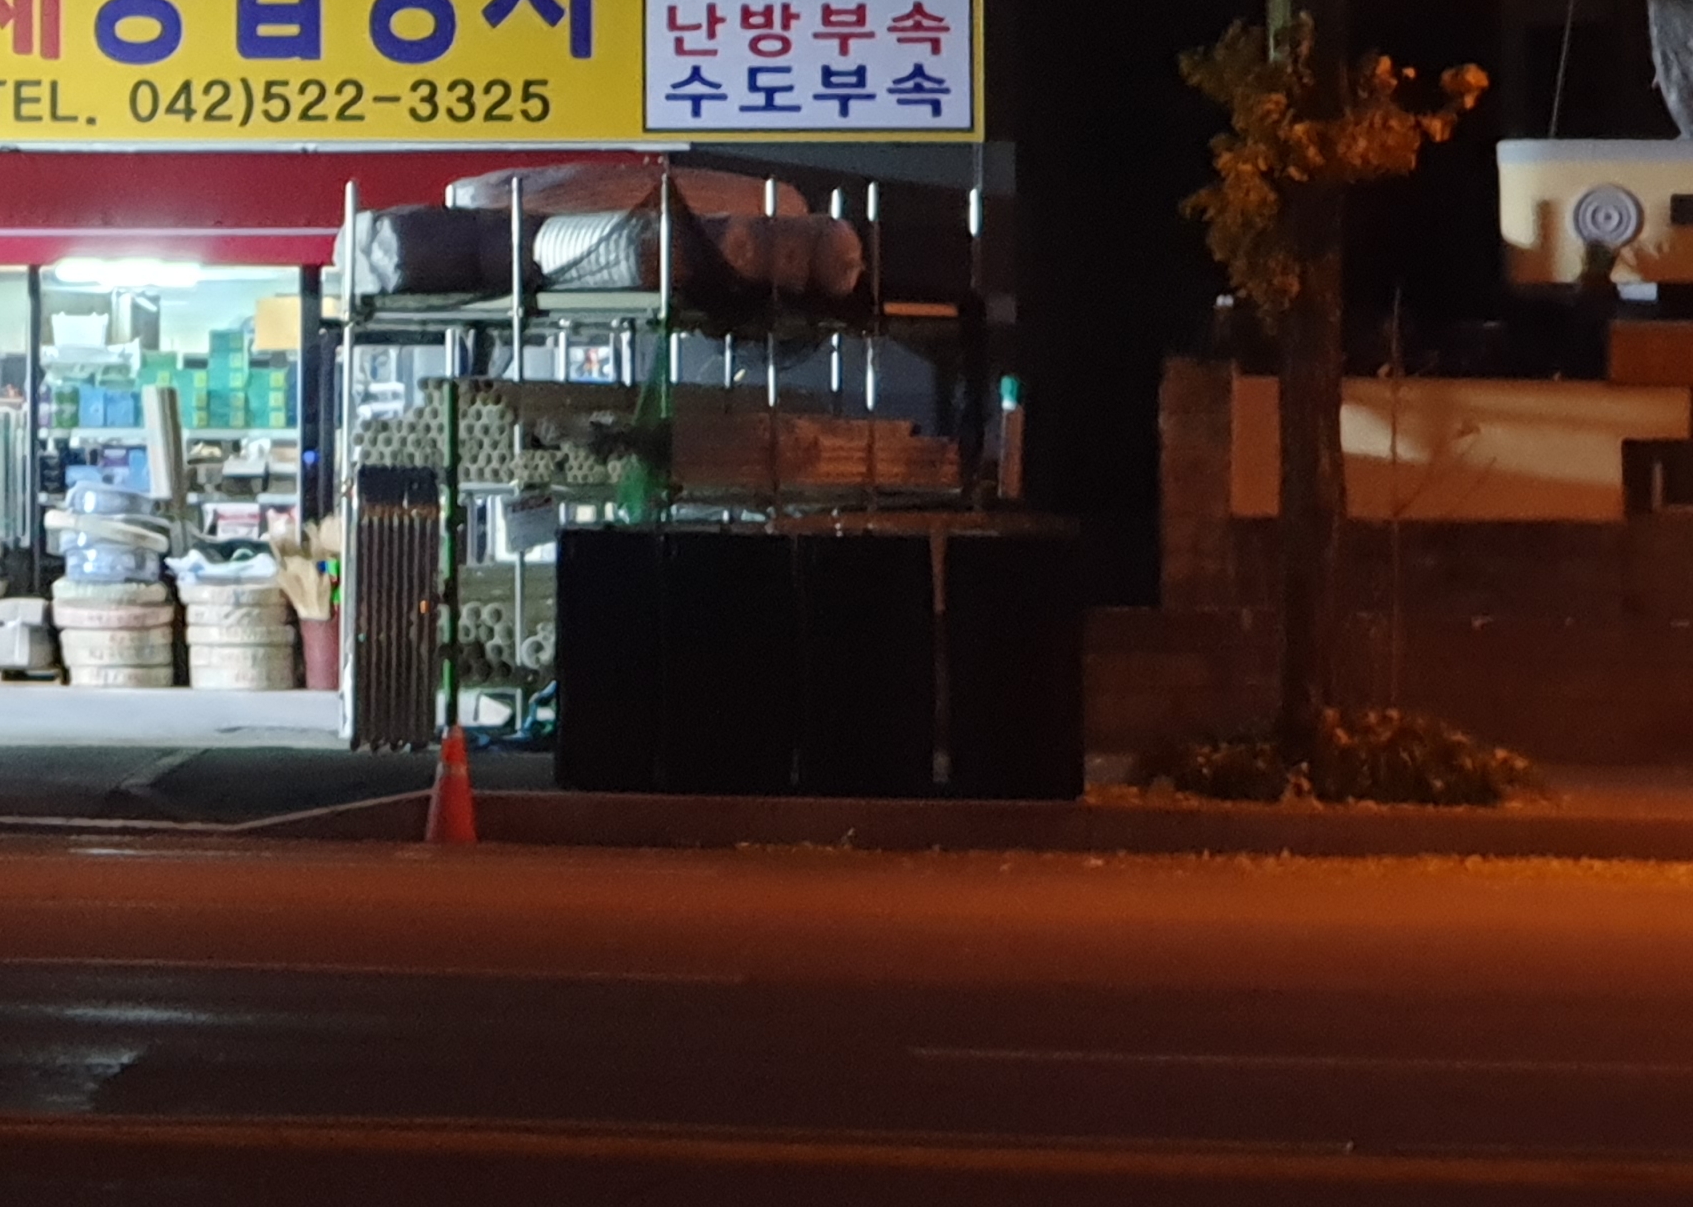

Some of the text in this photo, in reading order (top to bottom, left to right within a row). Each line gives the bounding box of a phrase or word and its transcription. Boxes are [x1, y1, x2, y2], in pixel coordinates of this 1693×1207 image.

[665, 1, 952, 58] 난방부속
[129, 77, 552, 128] 042)522-3325
[665, 63, 952, 119] 수도부속
